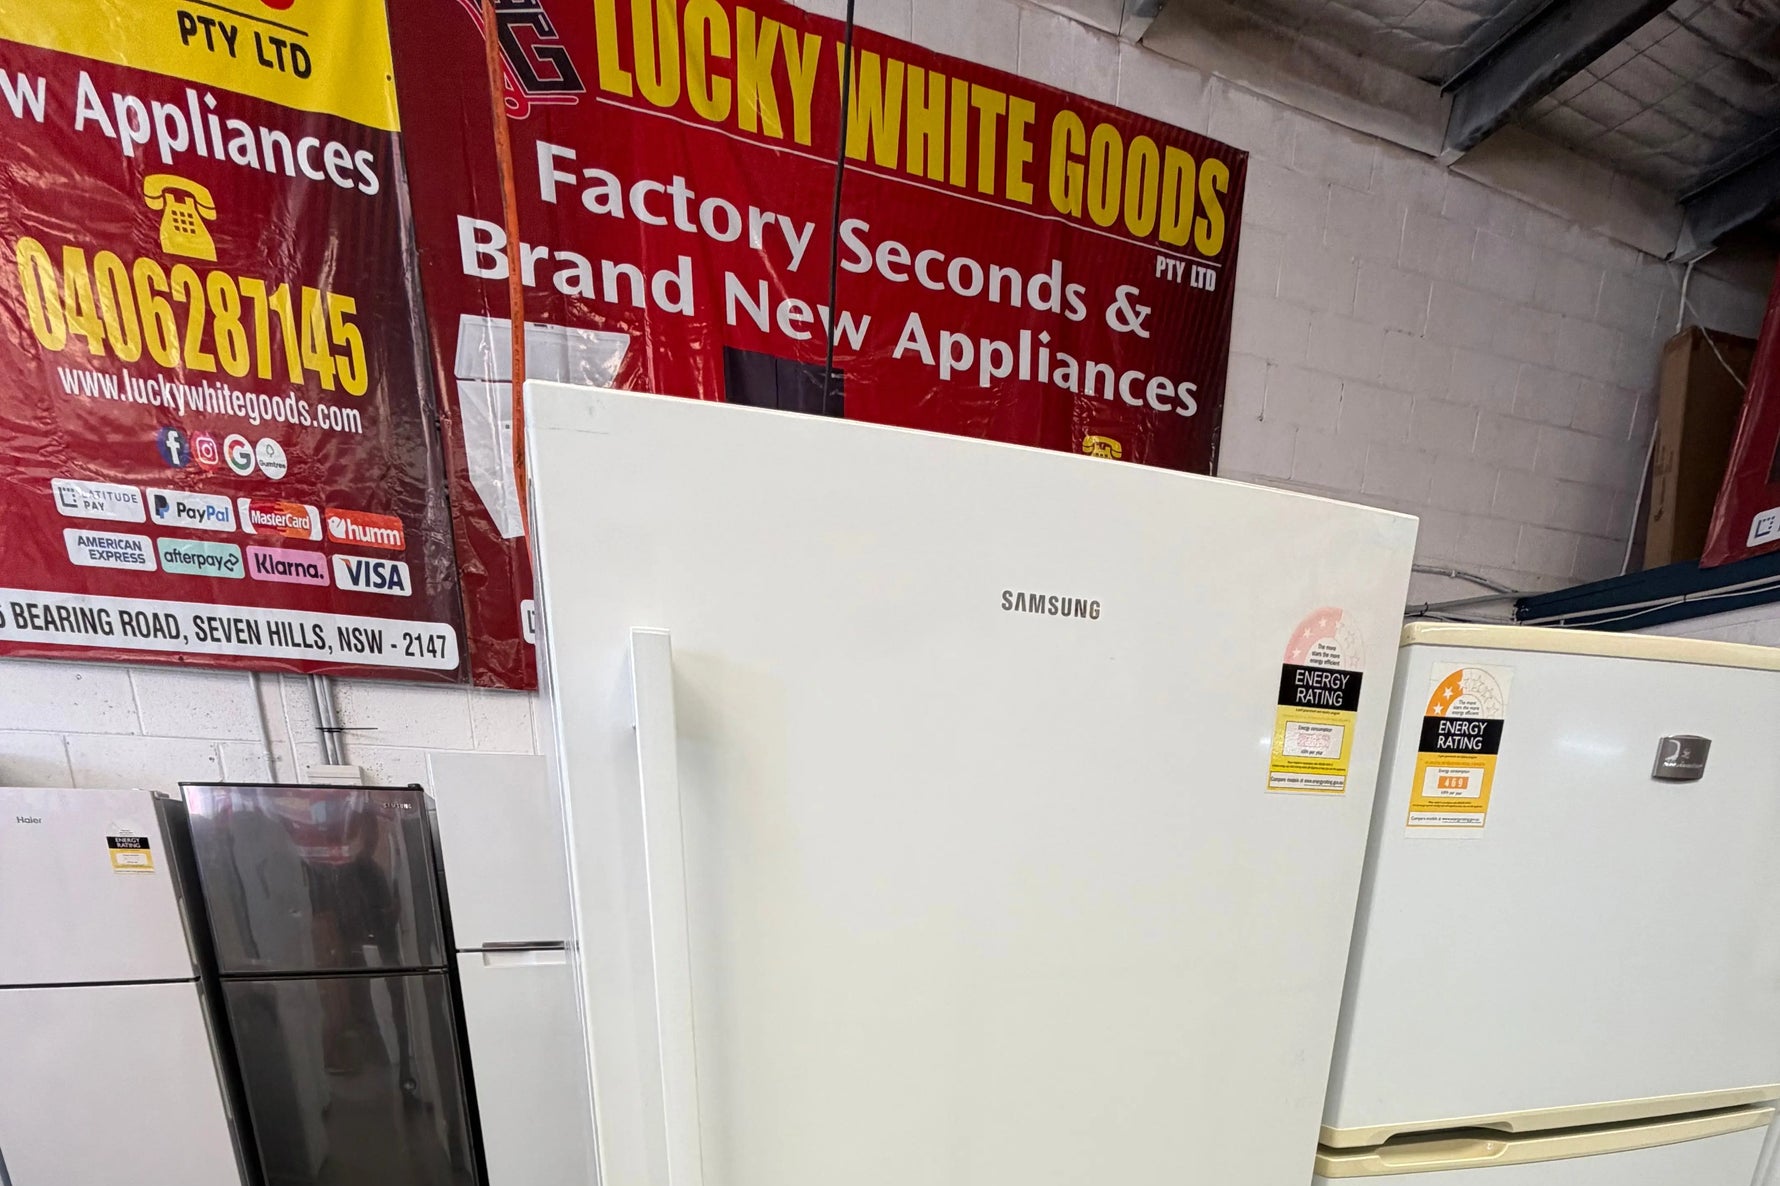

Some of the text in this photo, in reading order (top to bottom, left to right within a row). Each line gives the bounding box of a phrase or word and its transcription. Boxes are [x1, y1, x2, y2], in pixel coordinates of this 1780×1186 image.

[177, 9, 312, 79] PTY LTD
[74, 70, 380, 196] Appliances
[594, 0, 1229, 257] LUCKY WHITE GOODS
[536, 140, 1152, 338] Factory Seconds &
[1155, 255, 1217, 291] PTY LTD
[16, 236, 369, 396] 0406287145
[457, 214, 695, 317] Brand
[724, 271, 872, 350] New
[892, 312, 1199, 417] Appliances
[58, 366, 363, 434] www.luckywhitegoods.com
[259, 459, 287, 470] Gumtree
[84, 500, 105, 512] PAY
[177, 502, 230, 524] PayPal
[251, 510, 310, 531] MasterCard
[348, 519, 401, 546] humm
[77, 535, 142, 551] AMERICAN
[89, 549, 146, 565] EXPRESS
[163, 548, 223, 572] afterpay
[254, 552, 325, 580] Klarna.
[340, 557, 406, 592] VISA
[1001, 589, 1101, 620] SAMSUNG
[10, 601, 115, 637] BEARING
[118, 609, 189, 645] ROAD,
[193, 614, 262, 646] SEVEN
[266, 620, 333, 655] HILLS,
[337, 626, 384, 655] NSW
[402, 631, 447, 659] 2147
[1294, 669, 1350, 690] ENERGY
[1295, 687, 1344, 706] RATING
[1438, 719, 1488, 735] ENERGY
[1436, 735, 1483, 750] RATING
[16, 816, 42, 824] Haier
